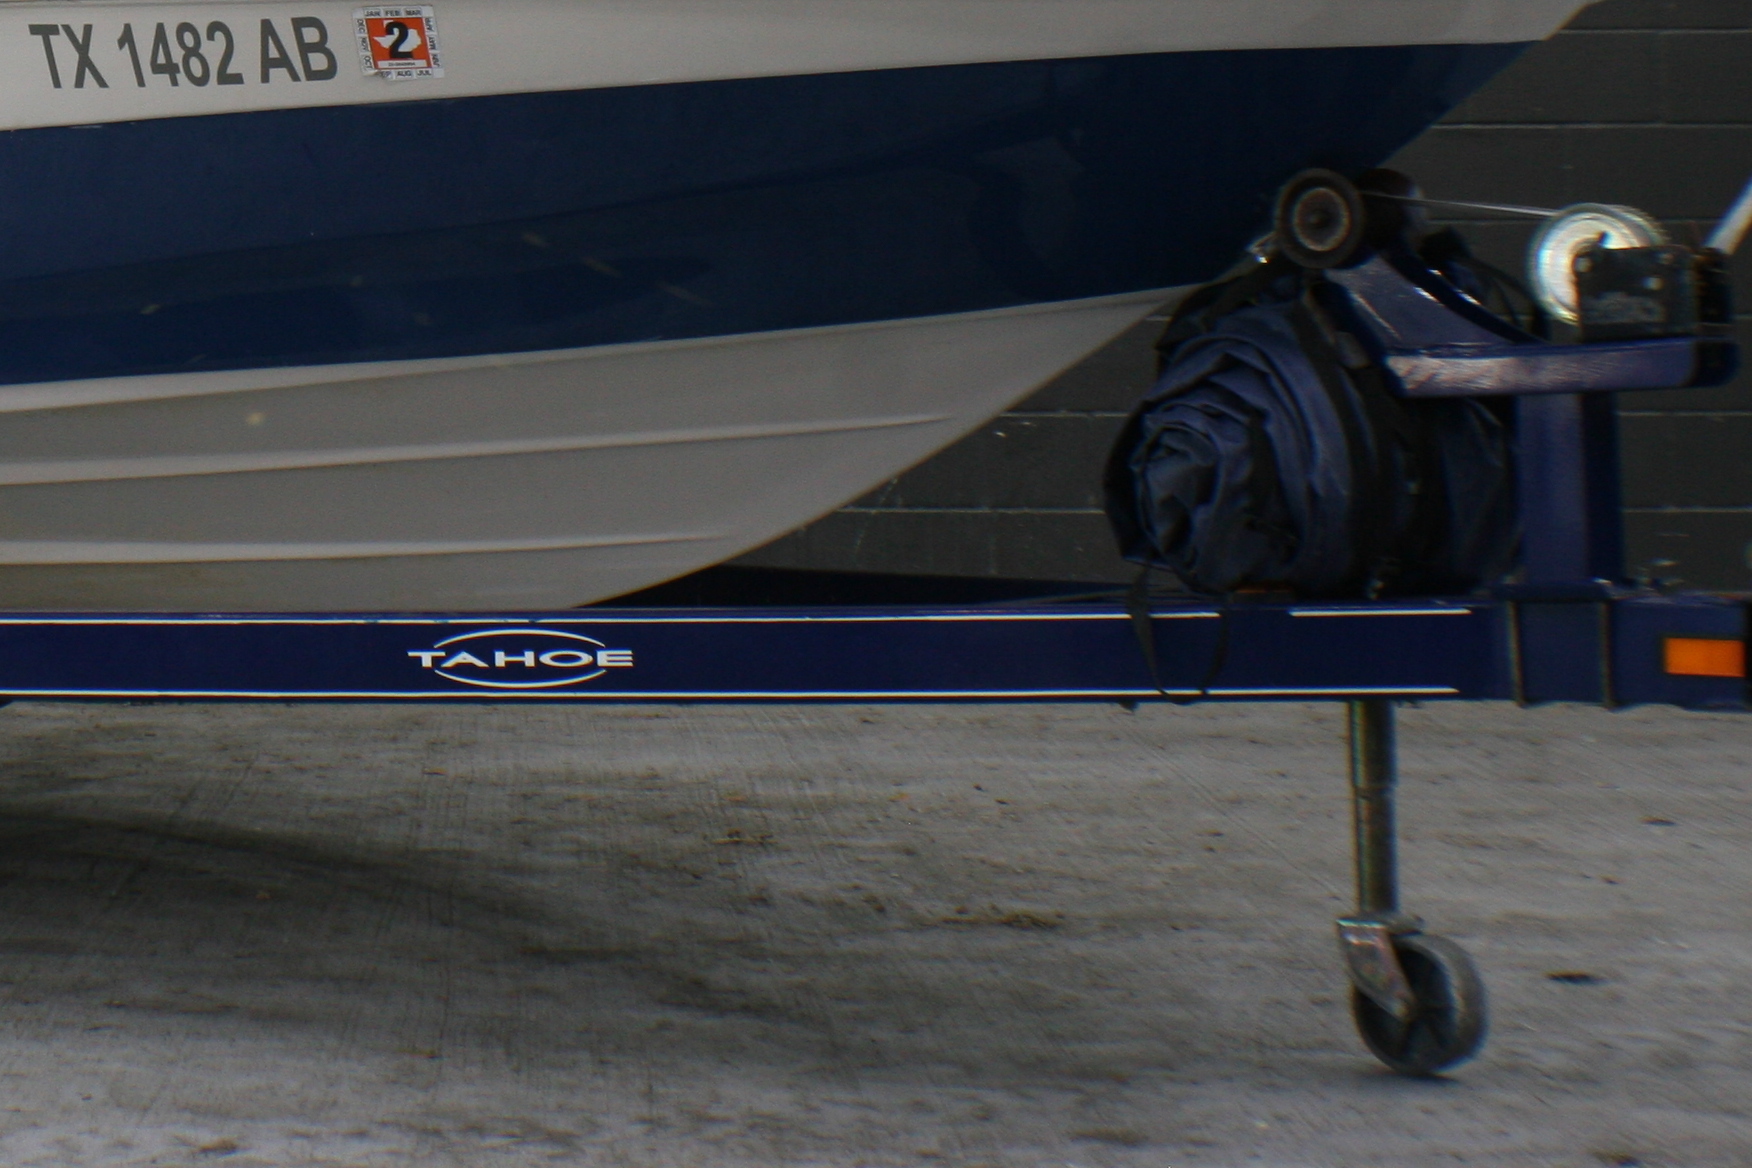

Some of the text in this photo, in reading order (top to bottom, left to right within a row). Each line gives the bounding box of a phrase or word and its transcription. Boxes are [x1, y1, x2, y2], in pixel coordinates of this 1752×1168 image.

[384, 9, 401, 17] FEB
[405, 8, 422, 16] MAR
[28, 16, 337, 89] TX 1482 AB
[385, 21, 413, 59] 2
[407, 650, 634, 668] TAHOE
